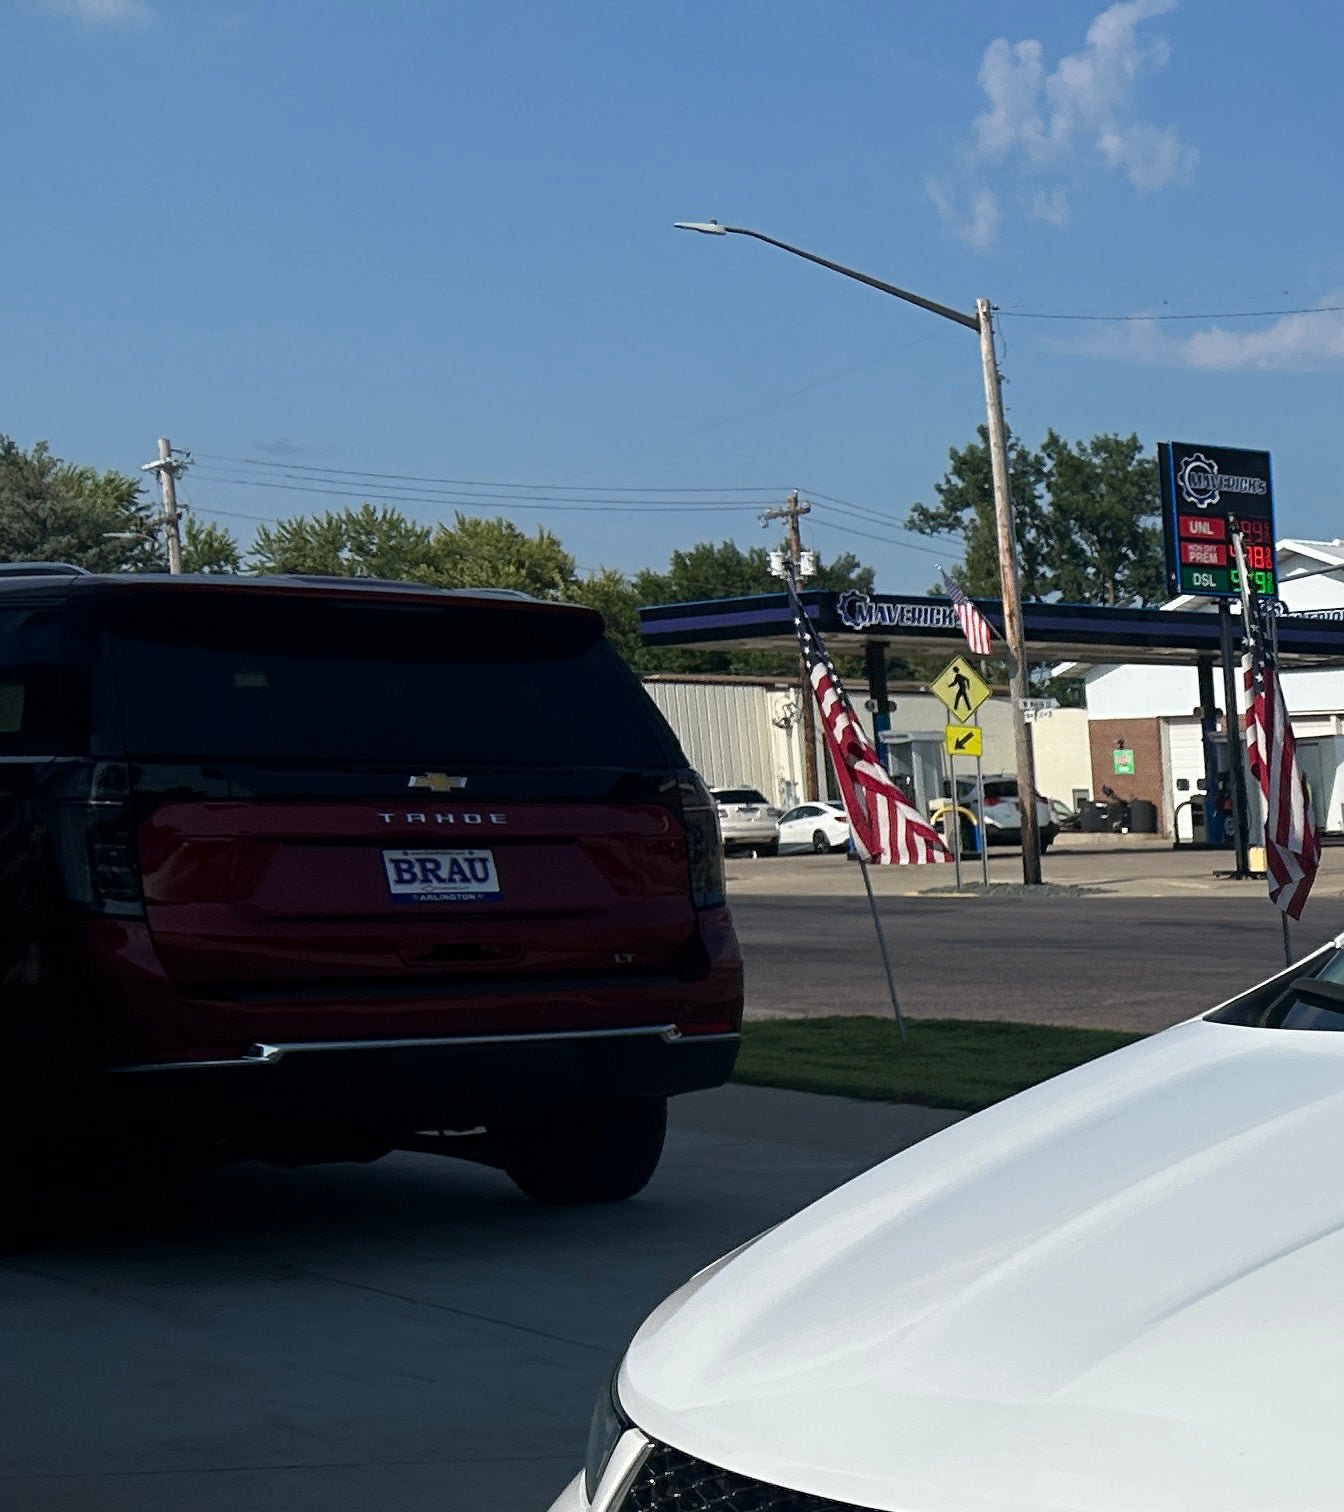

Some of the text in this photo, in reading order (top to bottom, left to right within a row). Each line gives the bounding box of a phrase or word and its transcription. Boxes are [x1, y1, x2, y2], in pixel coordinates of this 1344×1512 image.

[1189, 520, 1214, 535] UNL
[1189, 551, 1218, 564] PREM
[1192, 573, 1217, 587] DSL
[855, 602, 962, 628] MAVERICK
[378, 813, 507, 824] TAHOE
[389, 857, 490, 884] BRAU
[419, 893, 476, 901] ARLINGTON
